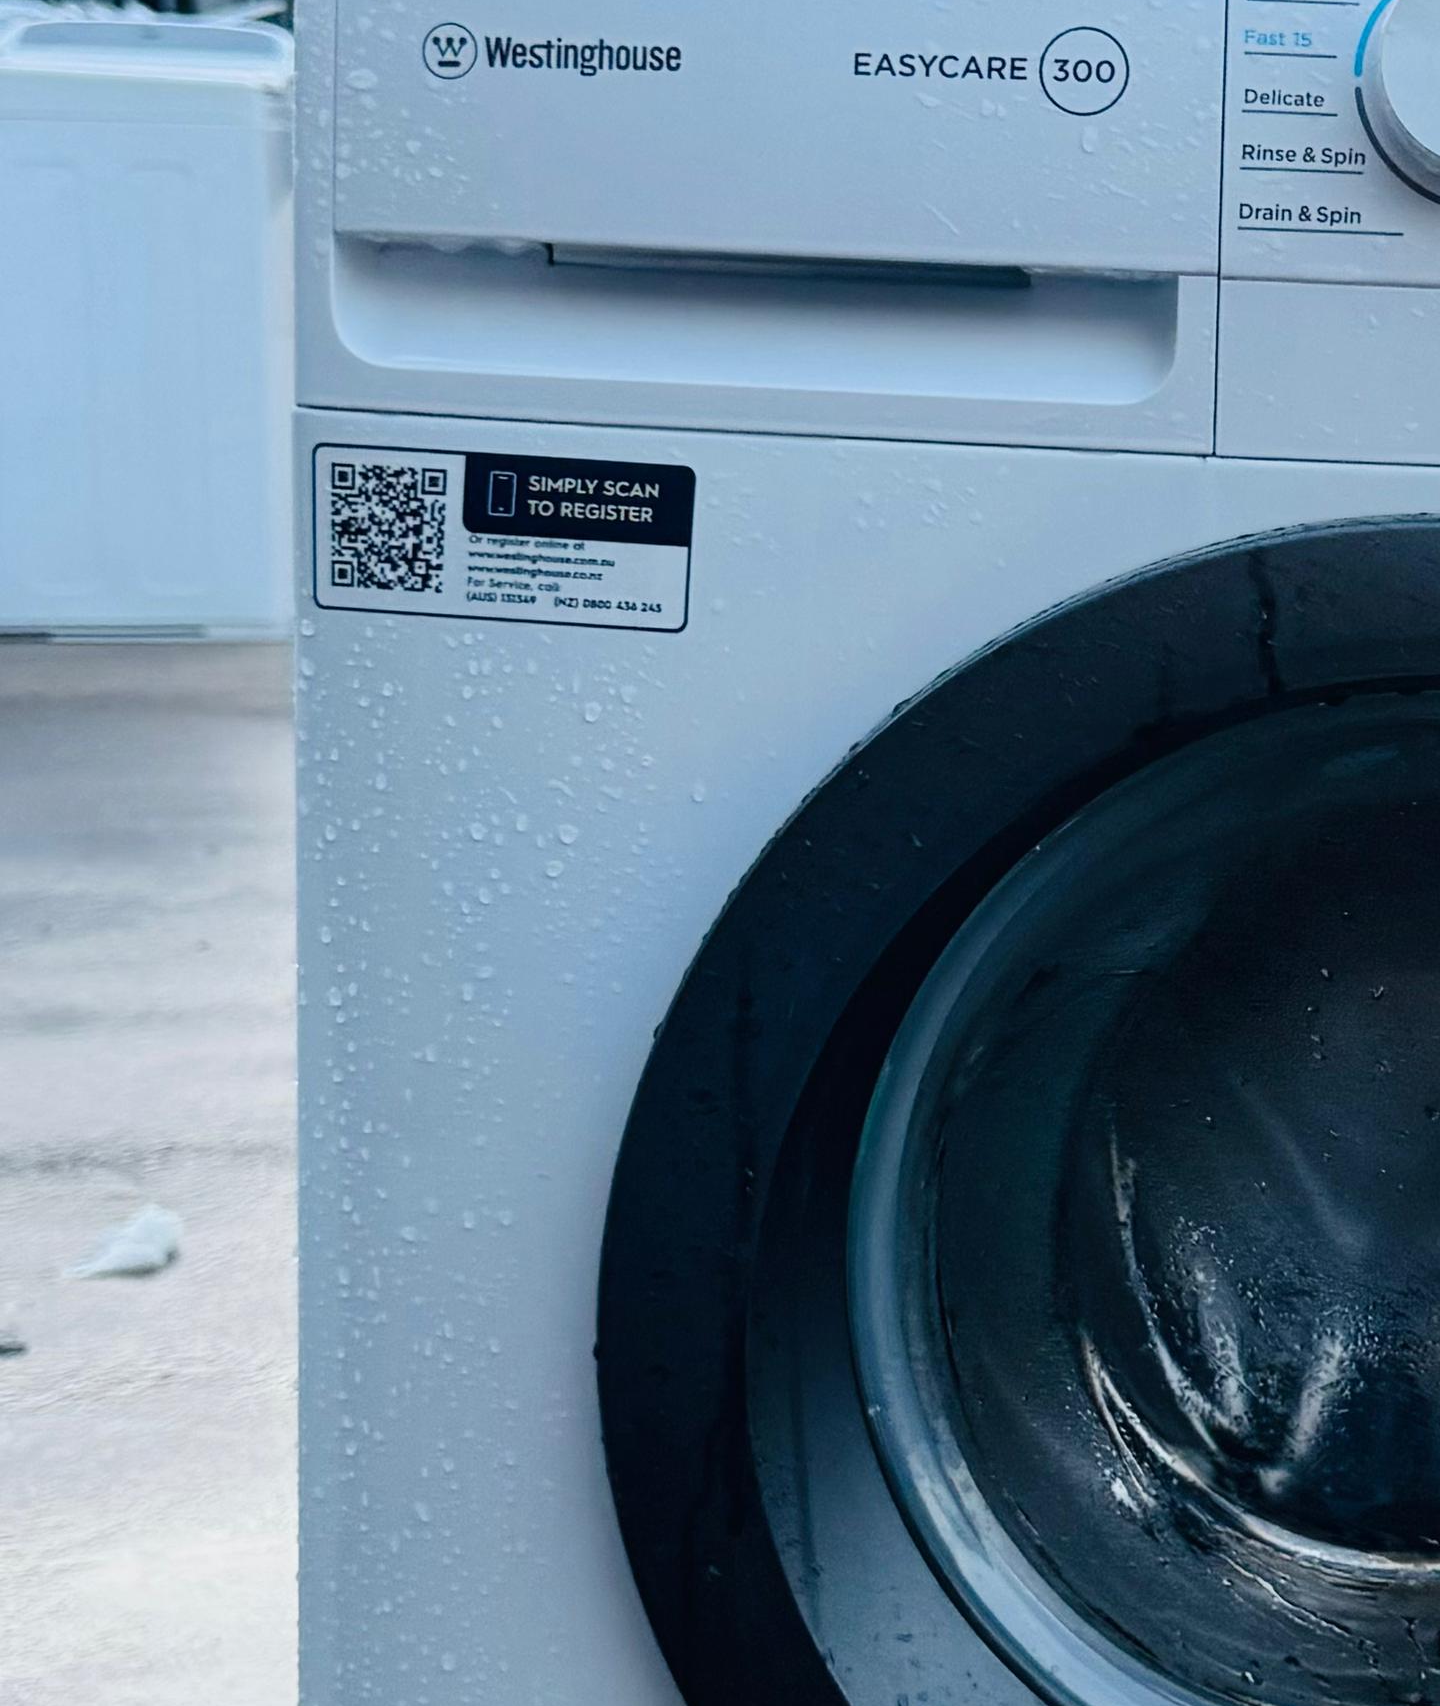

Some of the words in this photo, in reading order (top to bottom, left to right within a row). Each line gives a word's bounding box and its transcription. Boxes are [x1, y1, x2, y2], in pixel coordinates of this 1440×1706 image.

[1244, 29, 1286, 46] Fast
[1294, 32, 1312, 47] 15
[484, 36, 682, 76] Westinghouse
[854, 53, 1028, 80] EASYCARE
[1053, 59, 1116, 83] 300
[1244, 88, 1325, 107] Delicate
[1241, 144, 1297, 162] Rinse
[1302, 147, 1316, 163] &
[1321, 148, 1366, 167] Spin
[1239, 203, 1292, 221] Drain
[1298, 205, 1312, 222] &
[1316, 206, 1361, 226] Spin
[528, 475, 599, 496] SIMPLY
[603, 481, 660, 499] SCAN
[527, 499, 555, 516] TO
[559, 502, 654, 523] REGISTER
[469, 535, 483, 544] Or
[487, 537, 530, 550] register
[534, 540, 568, 550] online
[573, 541, 585, 550] at
[467, 577, 484, 587] For
[466, 591, 498, 603] (AUS)
[554, 596, 579, 609] (NZ)
